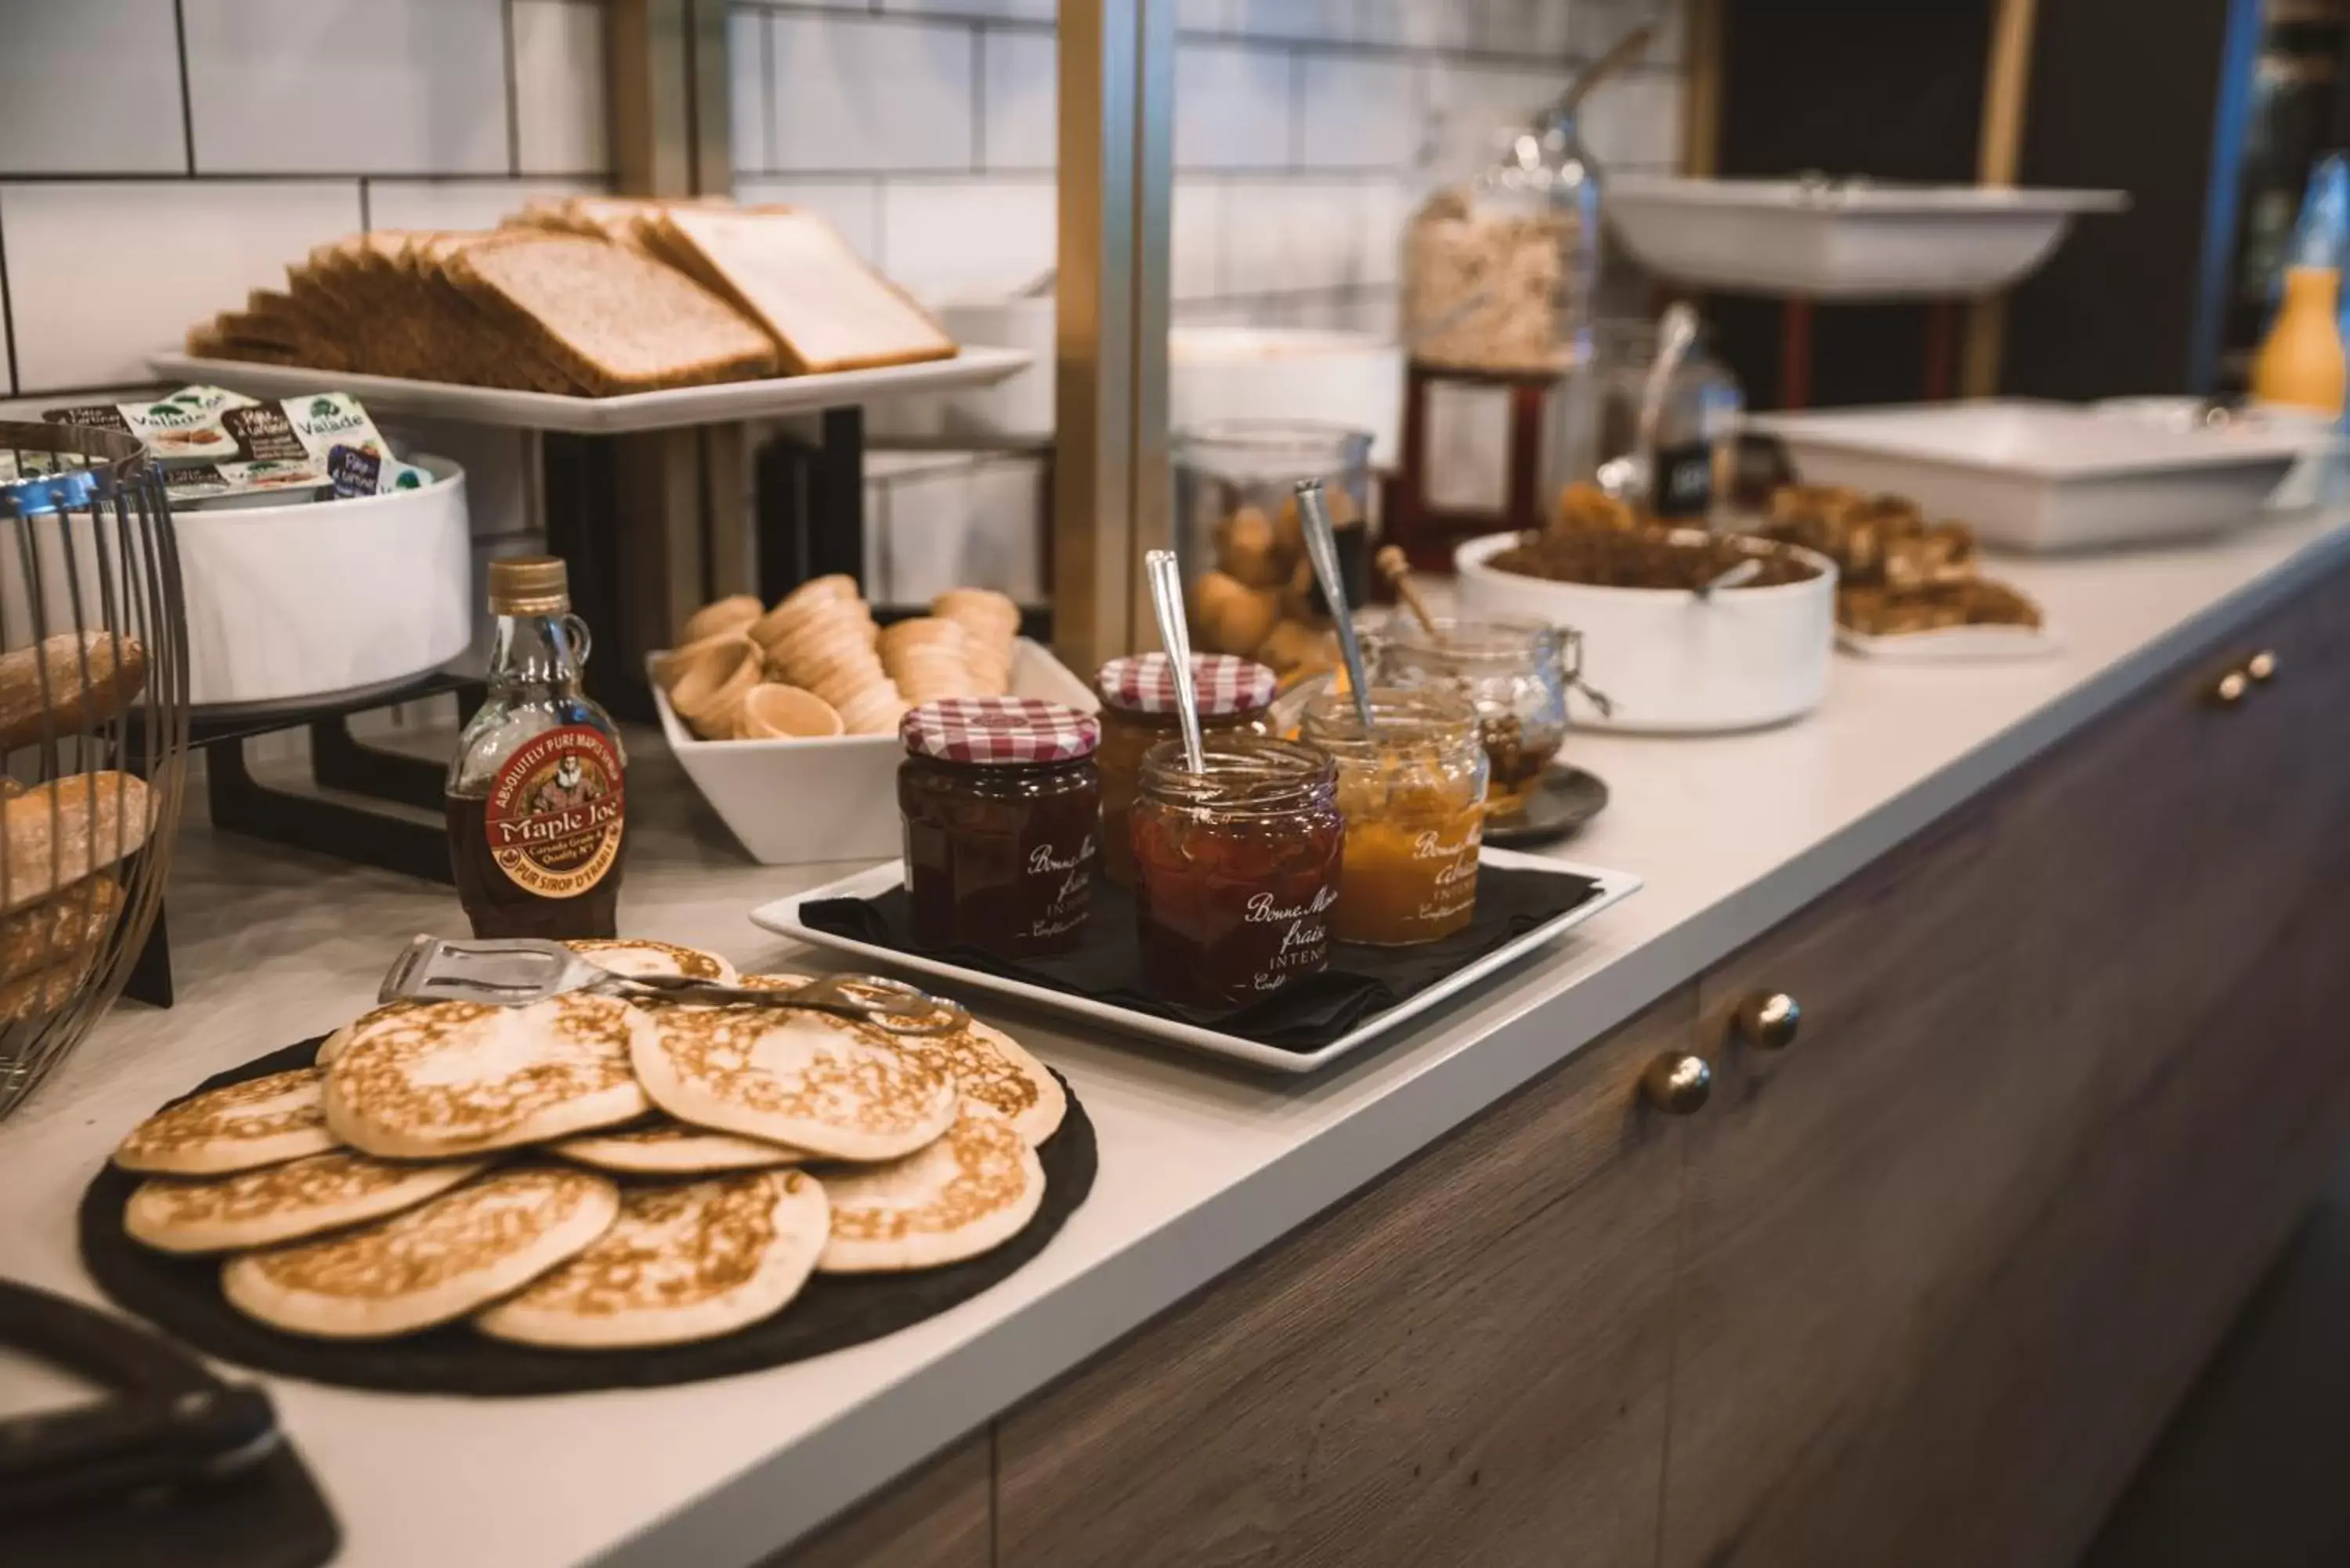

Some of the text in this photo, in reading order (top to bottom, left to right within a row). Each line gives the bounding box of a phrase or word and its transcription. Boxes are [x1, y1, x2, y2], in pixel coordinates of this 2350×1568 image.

[131, 411, 207, 428] Valade
[297, 411, 366, 437] Valade
[494, 743, 545, 810] ABSOLUTELY
[546, 732, 574, 753] PURE
[498, 800, 617, 843] Maple Joe
[514, 863, 540, 887] PUR
[539, 876, 573, 891] SIROP
[1245, 891, 1303, 923] Bonne
